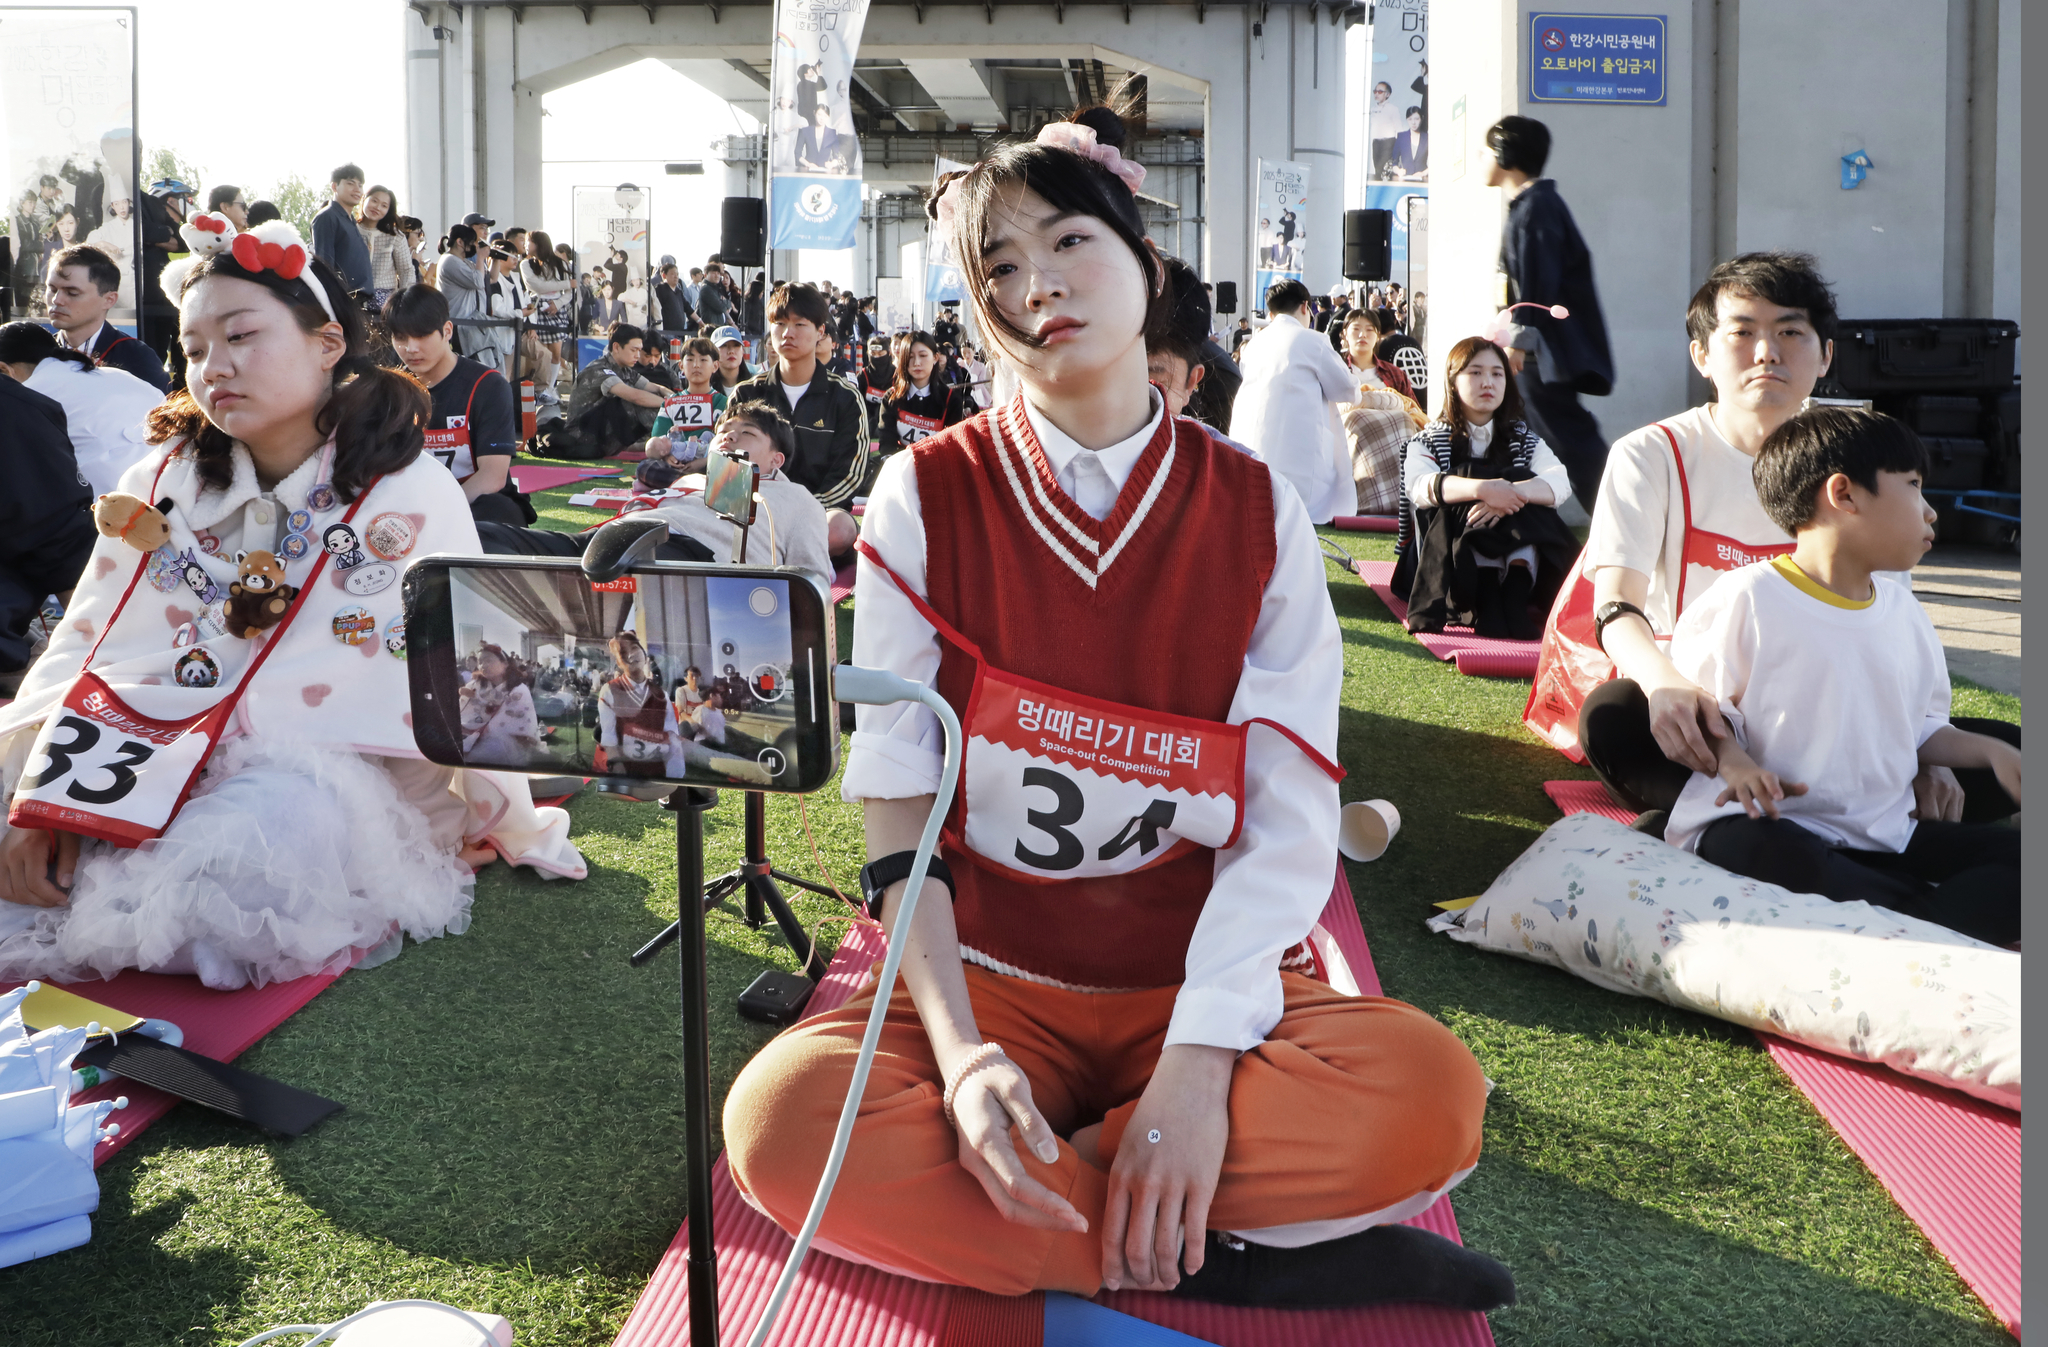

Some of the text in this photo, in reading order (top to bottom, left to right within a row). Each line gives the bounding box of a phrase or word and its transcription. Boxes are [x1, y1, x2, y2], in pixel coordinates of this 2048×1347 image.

[1569, 33, 1656, 49] 한강시민공원내
[1540, 56, 1656, 75] 오토바이 출입금지
[1576, 86, 1613, 94] 미래한강본부
[673, 405, 703, 425] 42
[437, 433, 455, 443] 대회
[336, 621, 373, 631] PPUPPA
[1017, 698, 1201, 769] 멍때리기 대회
[18, 715, 156, 805] 33
[1039, 737, 1170, 778] Space-out Competition
[1149, 1131, 1159, 1140] 34
